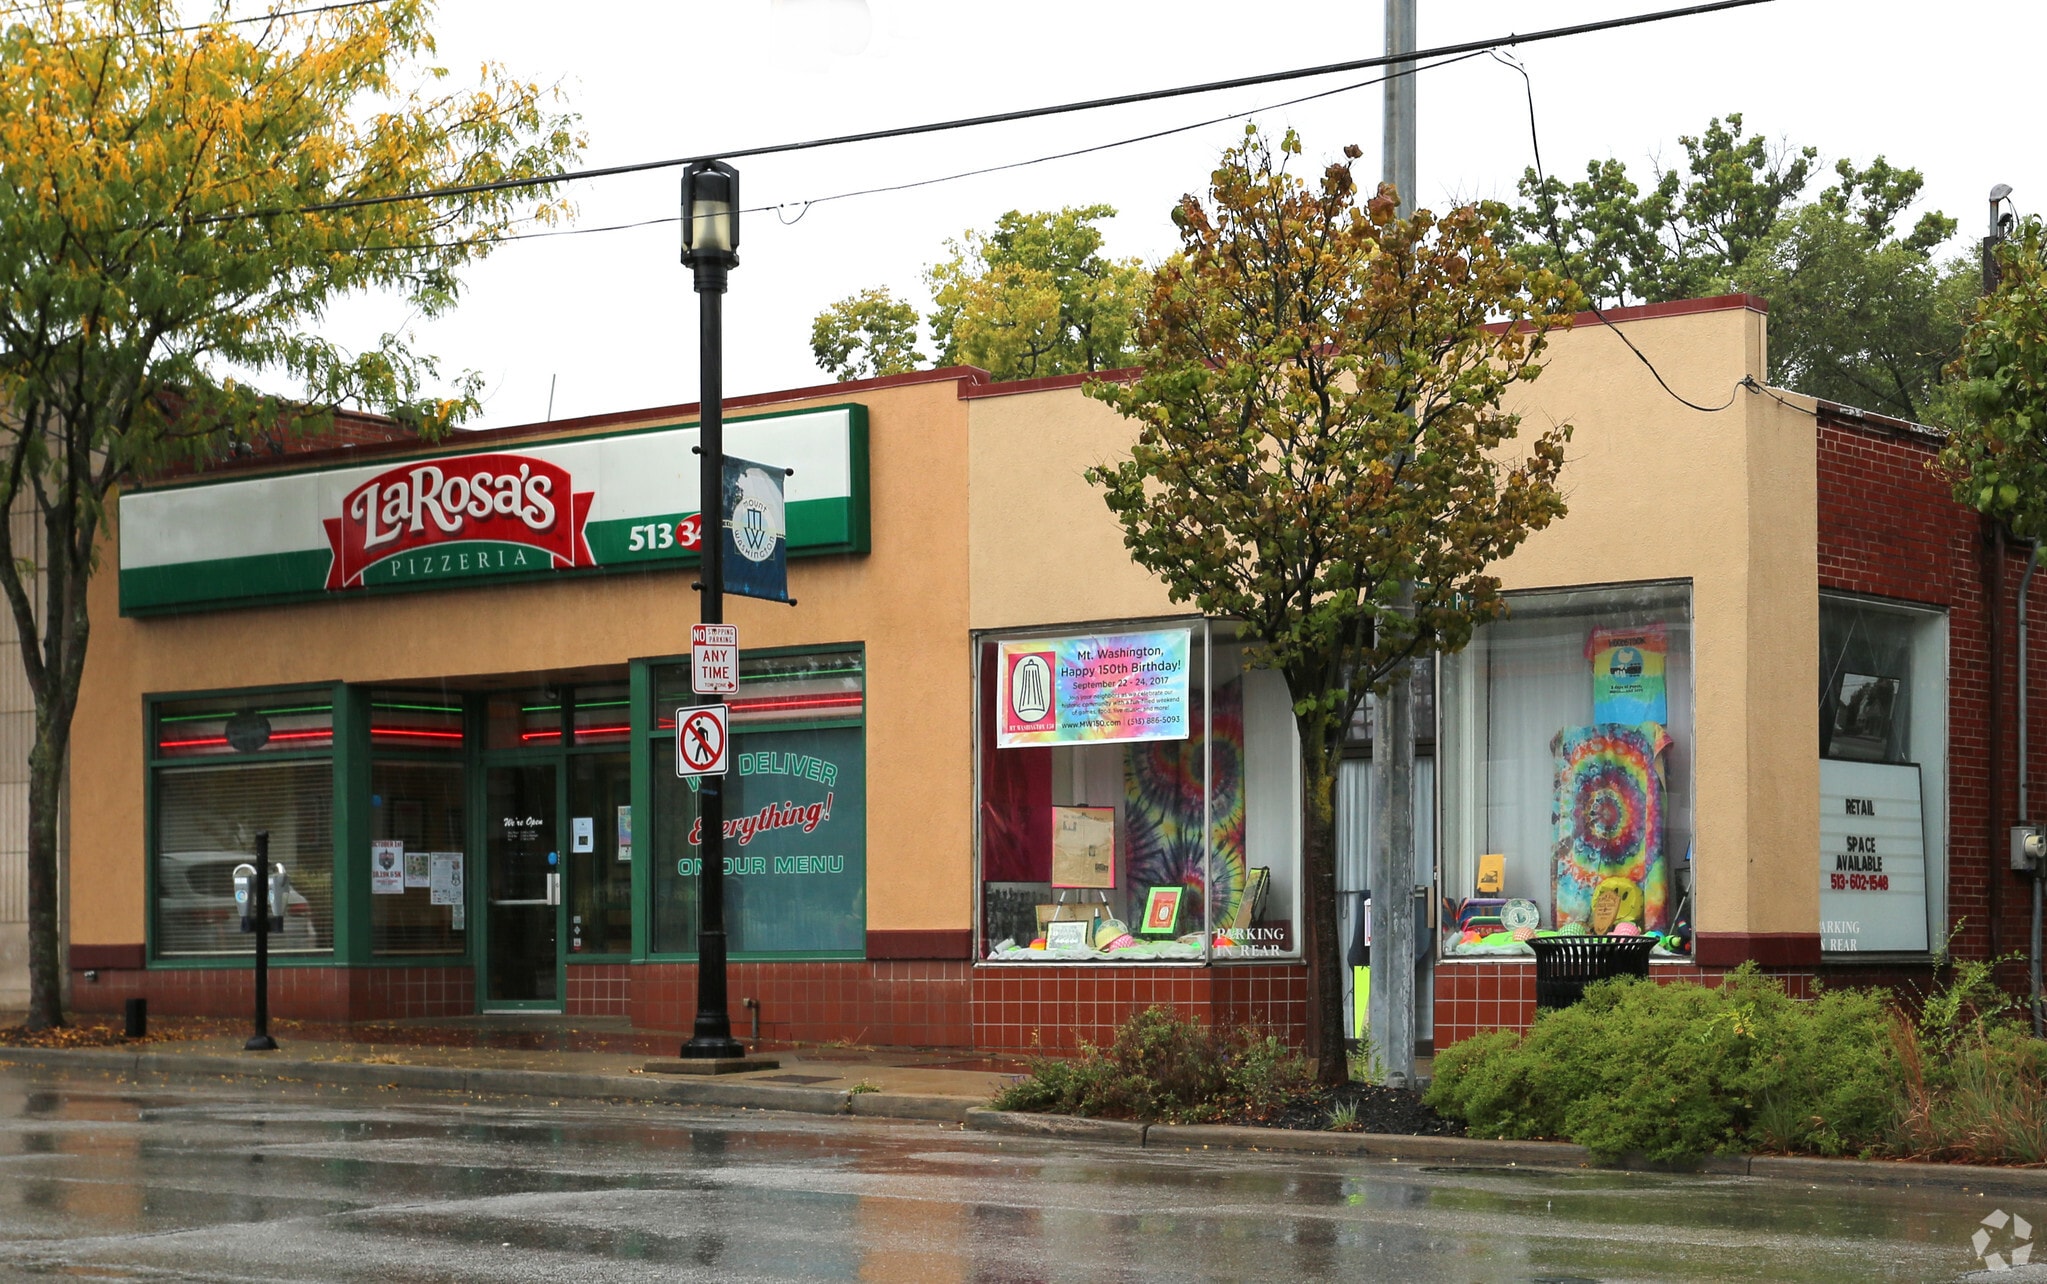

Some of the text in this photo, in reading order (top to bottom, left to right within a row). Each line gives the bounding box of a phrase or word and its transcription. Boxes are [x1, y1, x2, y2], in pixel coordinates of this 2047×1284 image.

[628, 523, 674, 551] 513
[391, 549, 528, 577] PIZZERIA
[693, 629, 706, 642] NO
[703, 650, 728, 662] ANY
[1077, 647, 1164, 661] Mt. Washington,
[702, 666, 730, 679] TIME
[1060, 660, 1182, 679] Happy 150th Birthday!
[1072, 681, 1116, 691] September
[1117, 679, 1128, 687] 22
[1135, 678, 1148, 687] 24,
[1150, 676, 1170, 686] 2017
[1082, 699, 1112, 708] community
[1156, 696, 1181, 704] weekend
[1093, 692, 1120, 701] neighbors
[1138, 690, 1163, 698] celebrate
[1061, 719, 1121, 729] www.MW150.com
[1146, 715, 1181, 725] 886-5093
[738, 751, 839, 787] DELIVER
[1845, 799, 1875, 816] RETAIL
[503, 816, 543, 828] We're Open
[687, 791, 835, 846] Eerything!
[1846, 836, 1876, 853] SPACE
[722, 856, 767, 876] OUR
[774, 855, 844, 874] MENU
[1836, 855, 1883, 872] AVAILABLE
[1216, 927, 1285, 941] PARKING
[1819, 920, 1861, 934] ARKING
[1216, 944, 1281, 957] IN REAR
[1830, 938, 1858, 952] REAR
